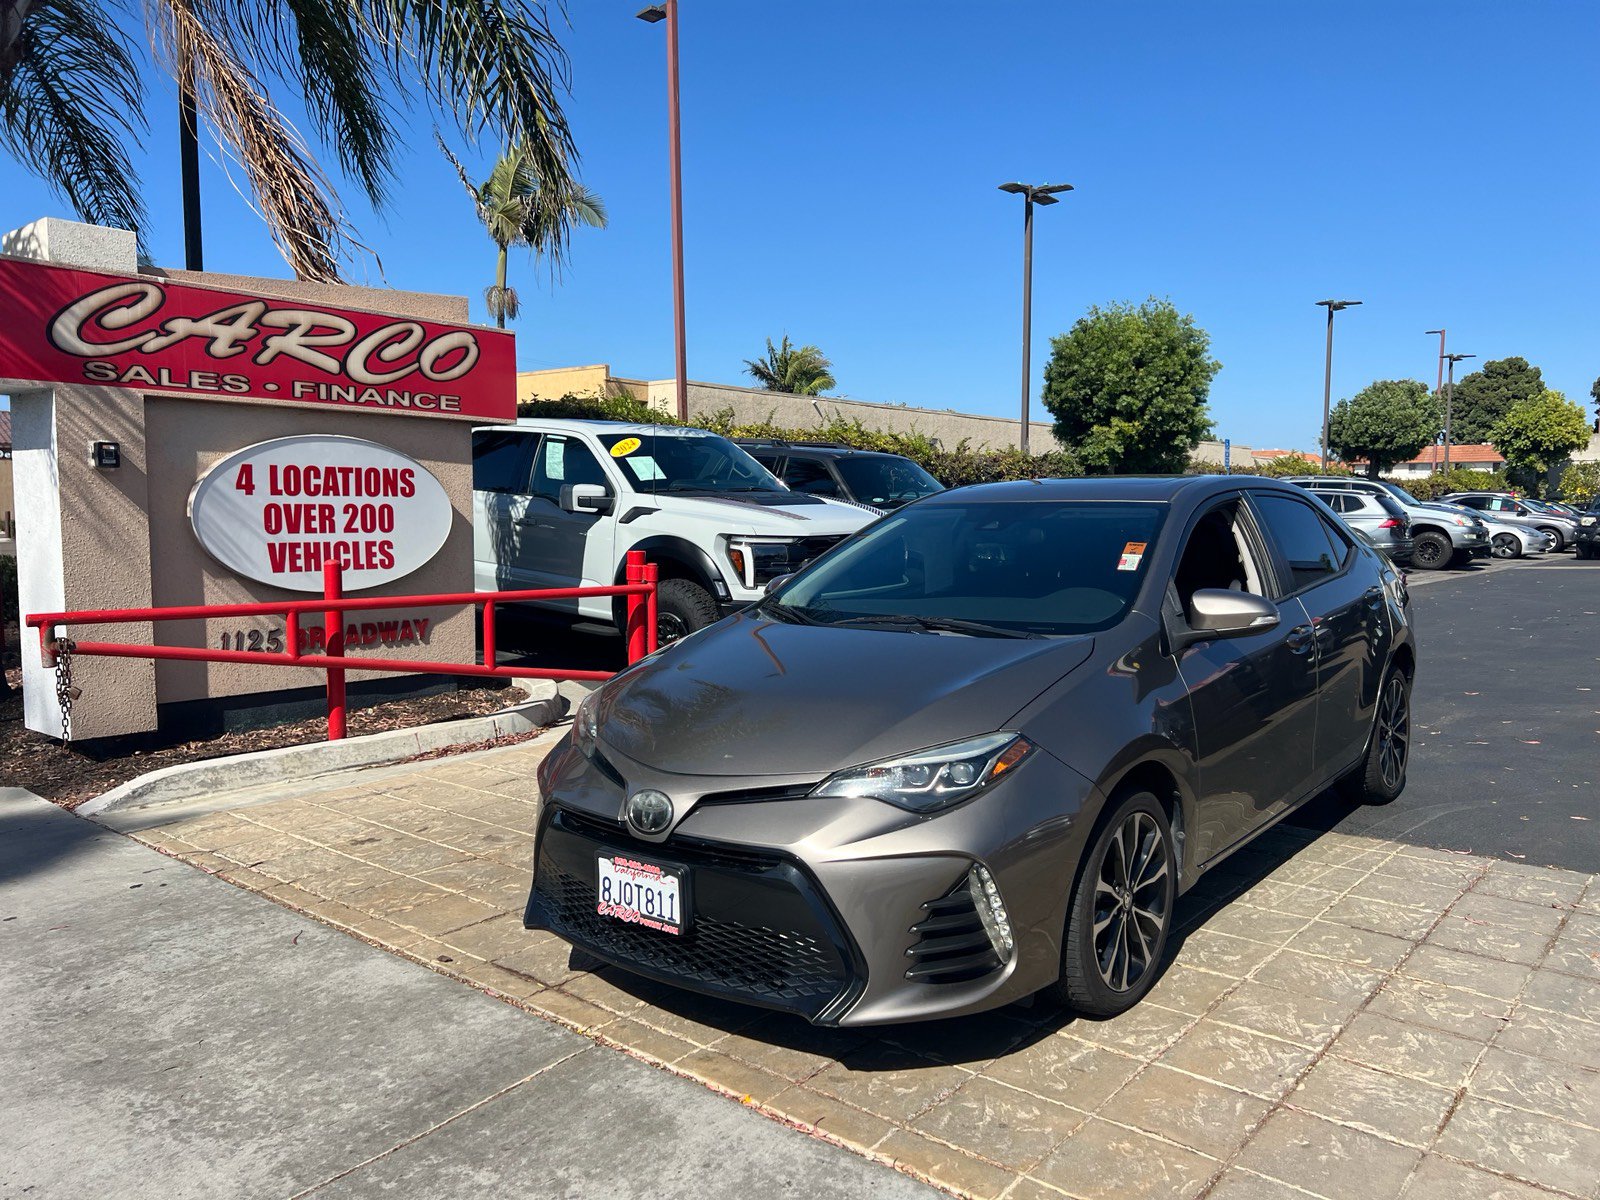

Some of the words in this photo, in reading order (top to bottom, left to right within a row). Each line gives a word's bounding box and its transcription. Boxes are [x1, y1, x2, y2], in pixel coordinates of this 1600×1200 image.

[46, 282, 480, 384] CARCO
[83, 361, 251, 394] SALES
[293, 381, 461, 412] FINANCE
[615, 439, 636, 456] 2024
[235, 463, 255, 496] 4
[269, 464, 416, 498] LOCATIONS
[263, 502, 336, 535] OVER
[342, 503, 395, 534] 200
[267, 539, 395, 573] VEHICLES
[221, 628, 283, 653] 1125
[298, 618, 429, 651] BRADWAY
